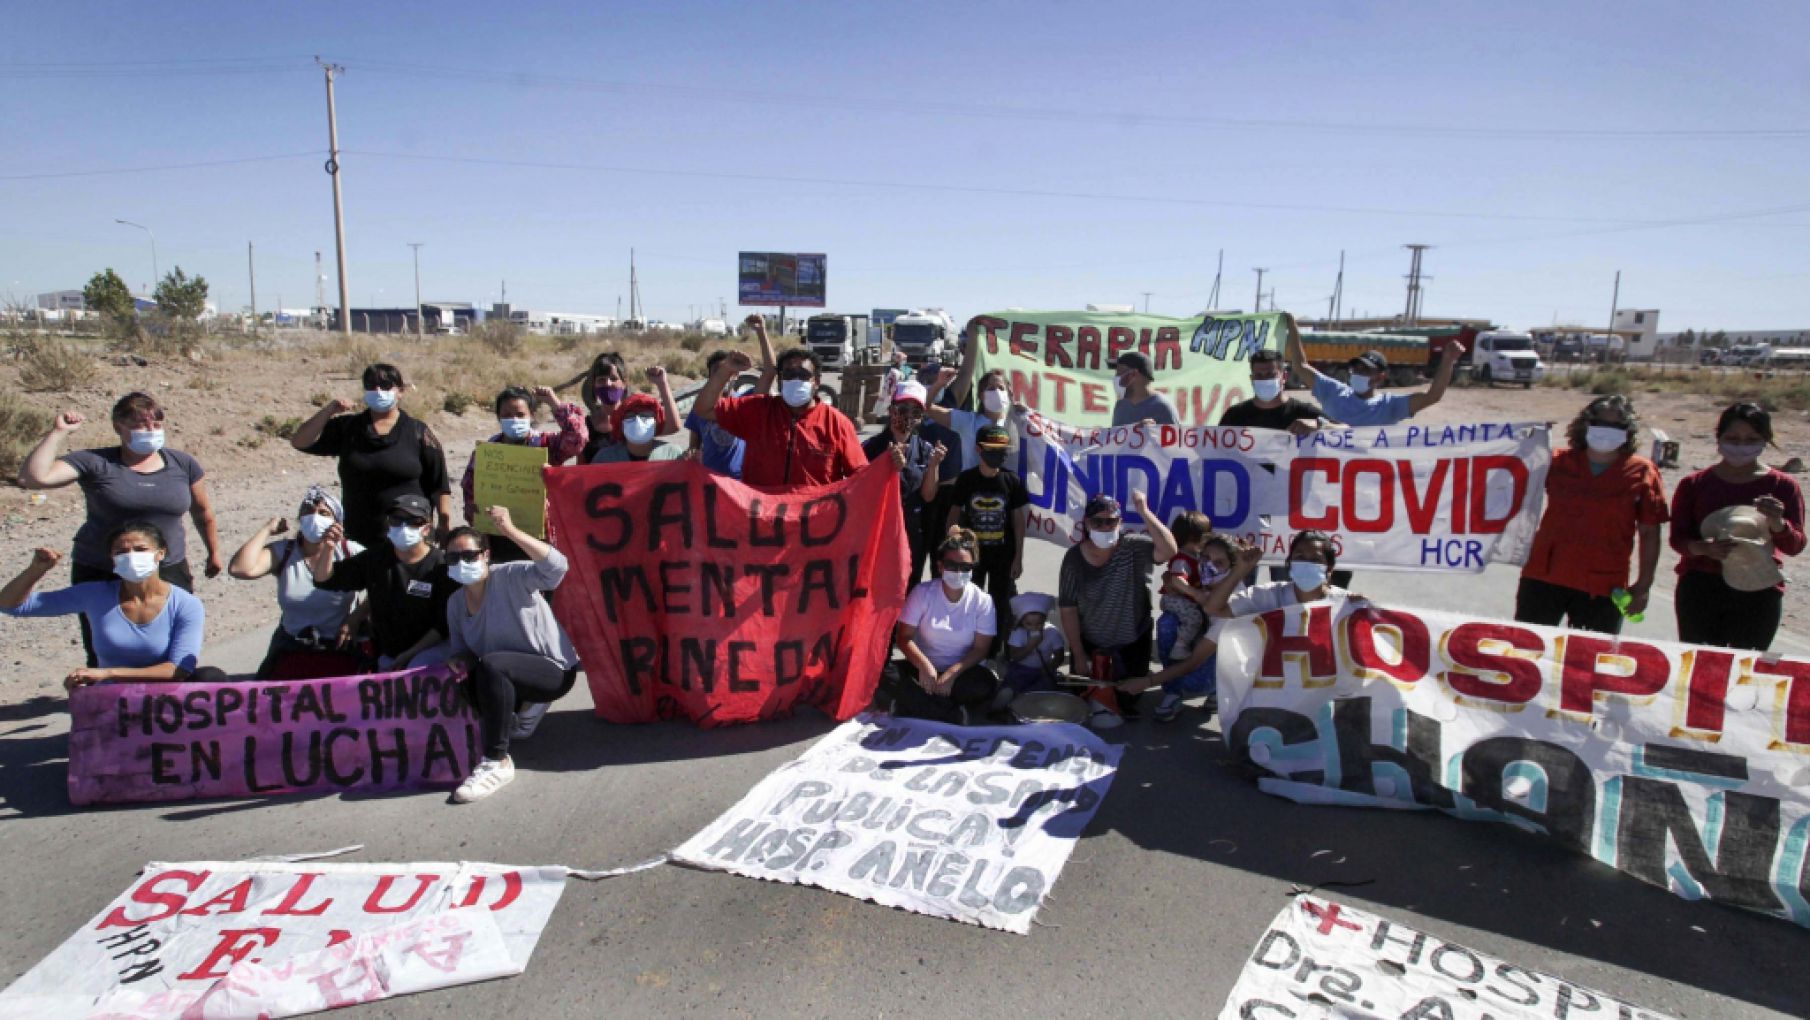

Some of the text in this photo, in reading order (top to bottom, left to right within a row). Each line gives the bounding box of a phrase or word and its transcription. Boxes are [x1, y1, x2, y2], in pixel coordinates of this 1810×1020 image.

[974, 315, 1183, 370] TERAPIA
[1161, 424, 1255, 451] DIGNOS
[1296, 423, 1514, 448] PASE A PLANTA
[1018, 437, 1529, 534] UNIDAD COVID
[585, 482, 847, 553] SALUD
[1421, 538, 1484, 567] HCR
[599, 553, 868, 623] MENTAL
[619, 624, 846, 696] RINCON
[118, 683, 347, 737] HOSPITAL
[151, 742, 221, 785] EN
[95, 870, 522, 930] SALUD
